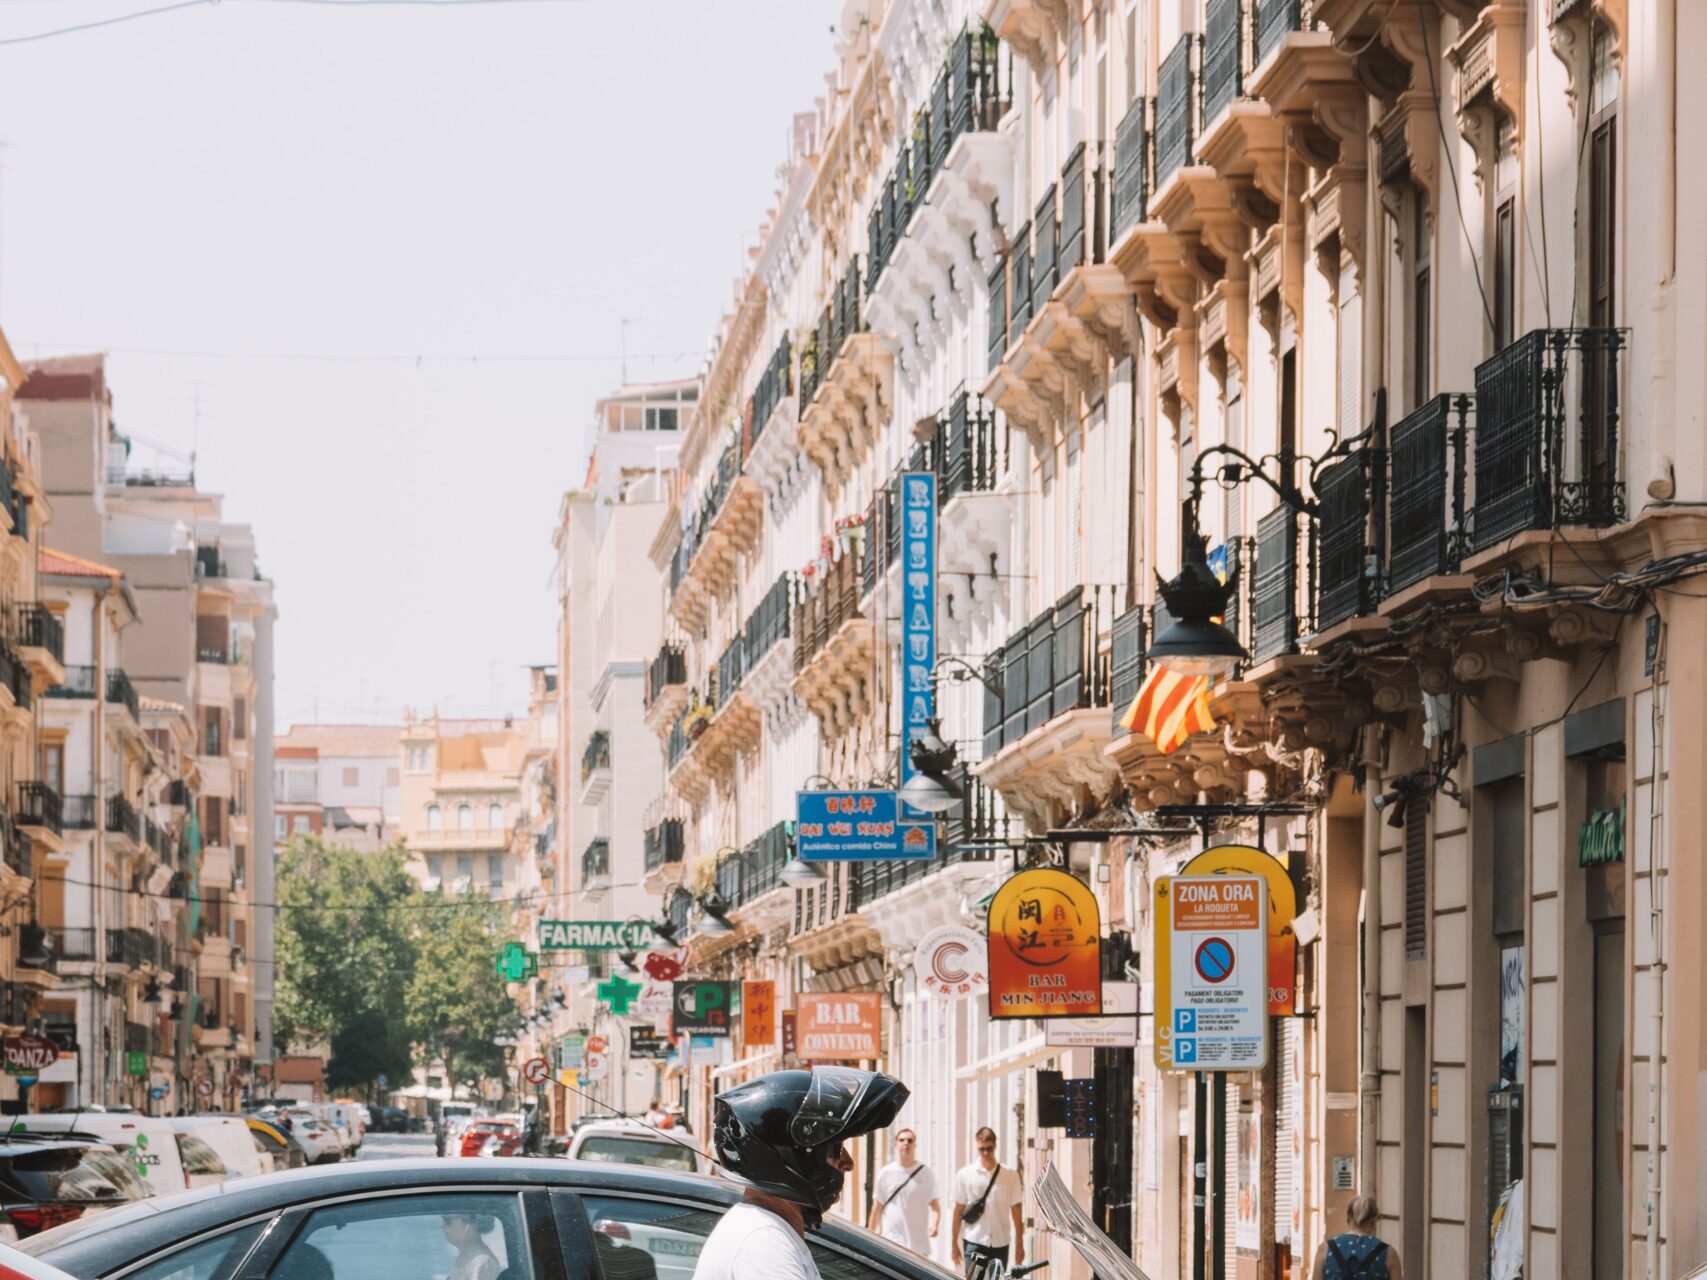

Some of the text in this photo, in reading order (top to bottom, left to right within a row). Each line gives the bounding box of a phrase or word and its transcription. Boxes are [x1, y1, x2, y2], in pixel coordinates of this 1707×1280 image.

[908, 479, 932, 816] RESTAURA
[800, 823, 823, 838] BAI
[828, 821, 852, 836] WEI
[1178, 884, 1254, 902] ZONA ORA
[1193, 903, 1239, 913] LA ROQUETA
[540, 924, 654, 946] FARMACIA
[1028, 974, 1067, 988] BAR
[1000, 993, 1035, 1006] MIN
[1039, 991, 1096, 1006] JIANG
[815, 1002, 861, 1025] BAR
[1179, 1011, 1192, 1031] P
[804, 1033, 873, 1051] CONVENTO
[1159, 1026, 1172, 1063] VLC
[1180, 1041, 1192, 1060] P
